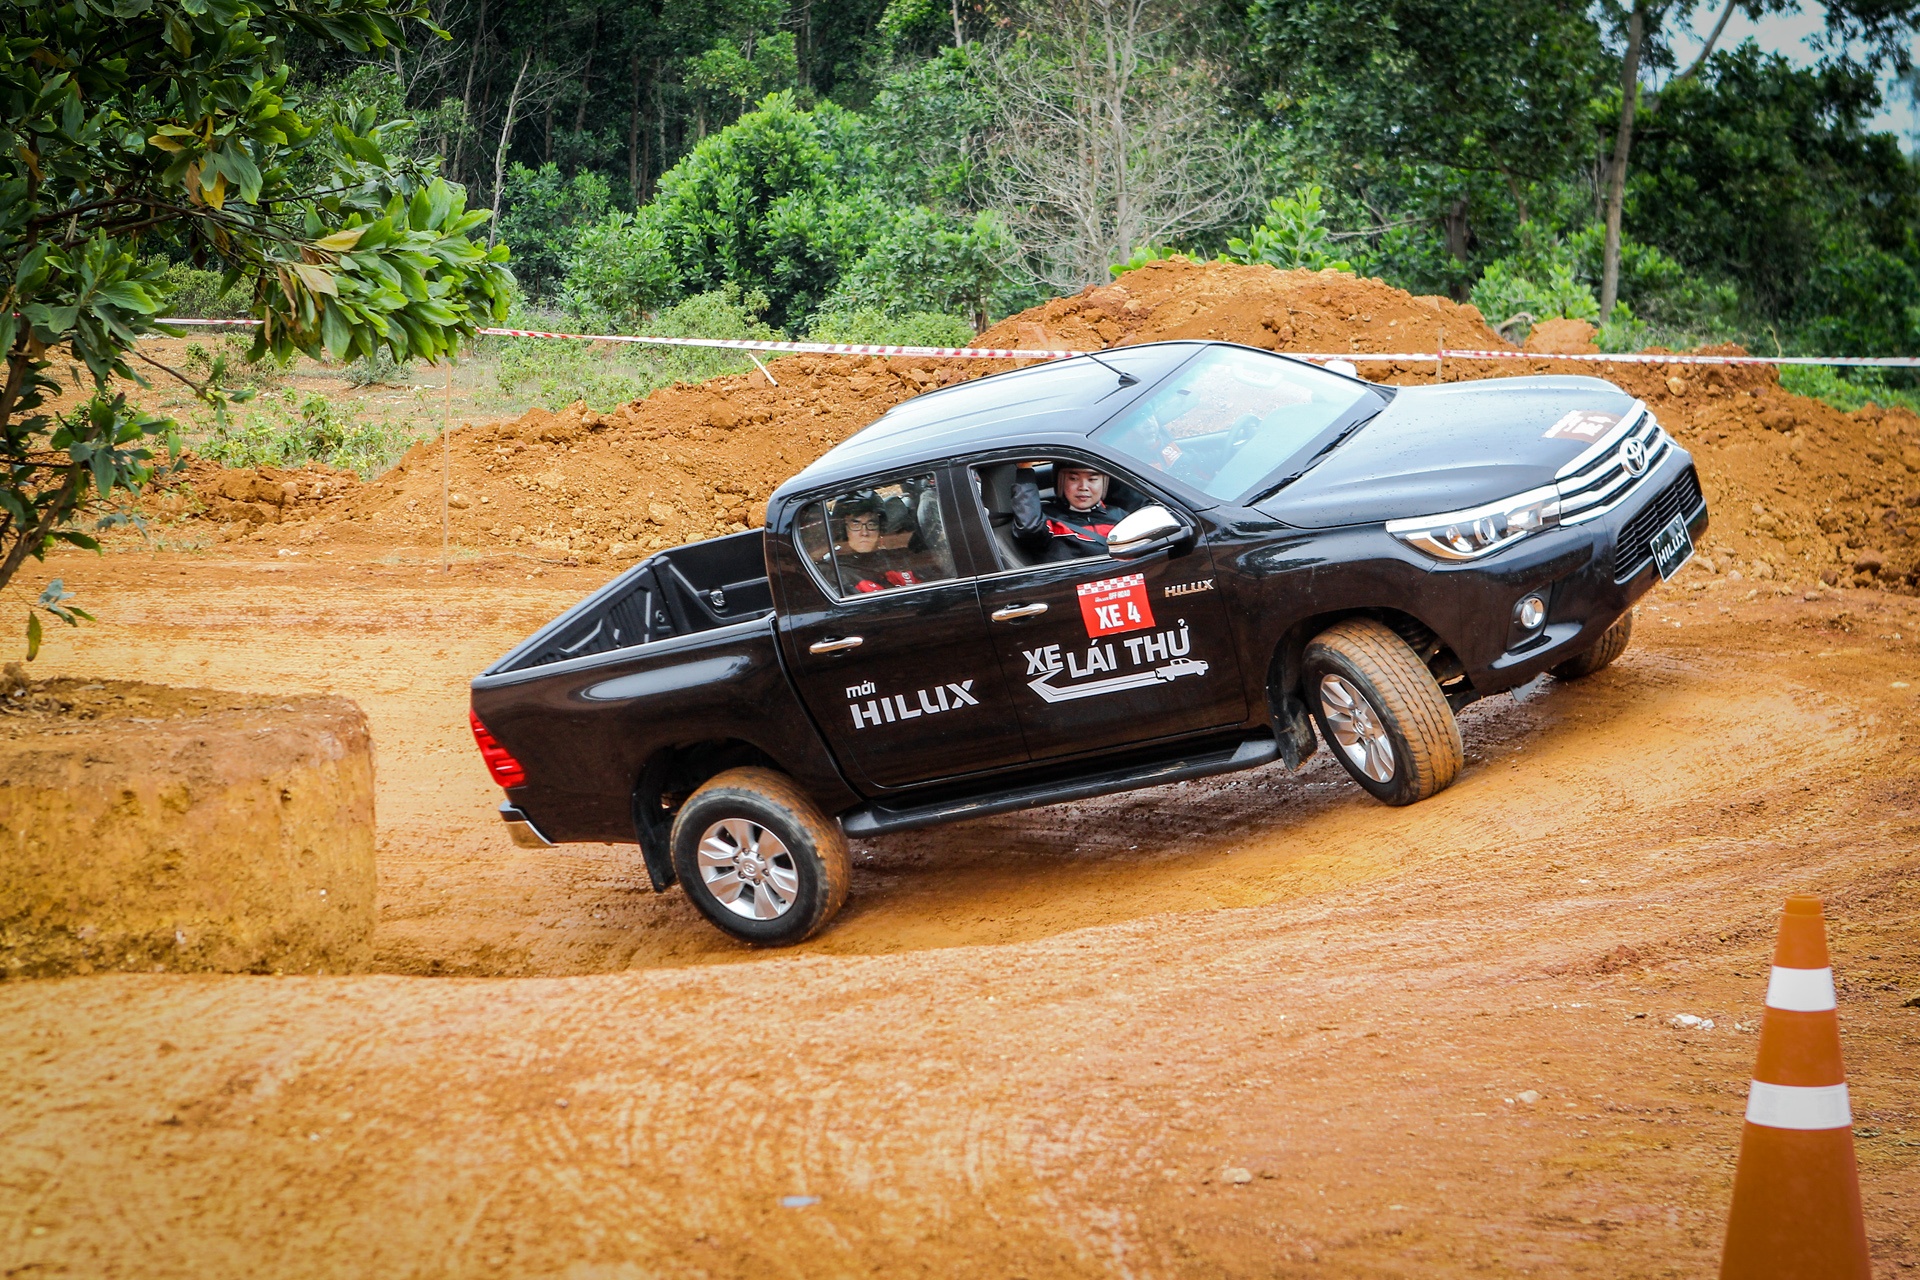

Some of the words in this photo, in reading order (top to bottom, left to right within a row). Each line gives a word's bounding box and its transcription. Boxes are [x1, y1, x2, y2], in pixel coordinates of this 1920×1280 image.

[1657, 529, 1687, 567] HILUX
[1164, 578, 1214, 598] HILUX
[1094, 604, 1124, 630] XE
[1127, 601, 1142, 623] 4
[1022, 643, 1064, 675] XE
[1066, 638, 1118, 679] LÁI
[1123, 618, 1191, 665] THỬ
[845, 680, 876, 699] mới
[849, 679, 980, 729] HILUX
